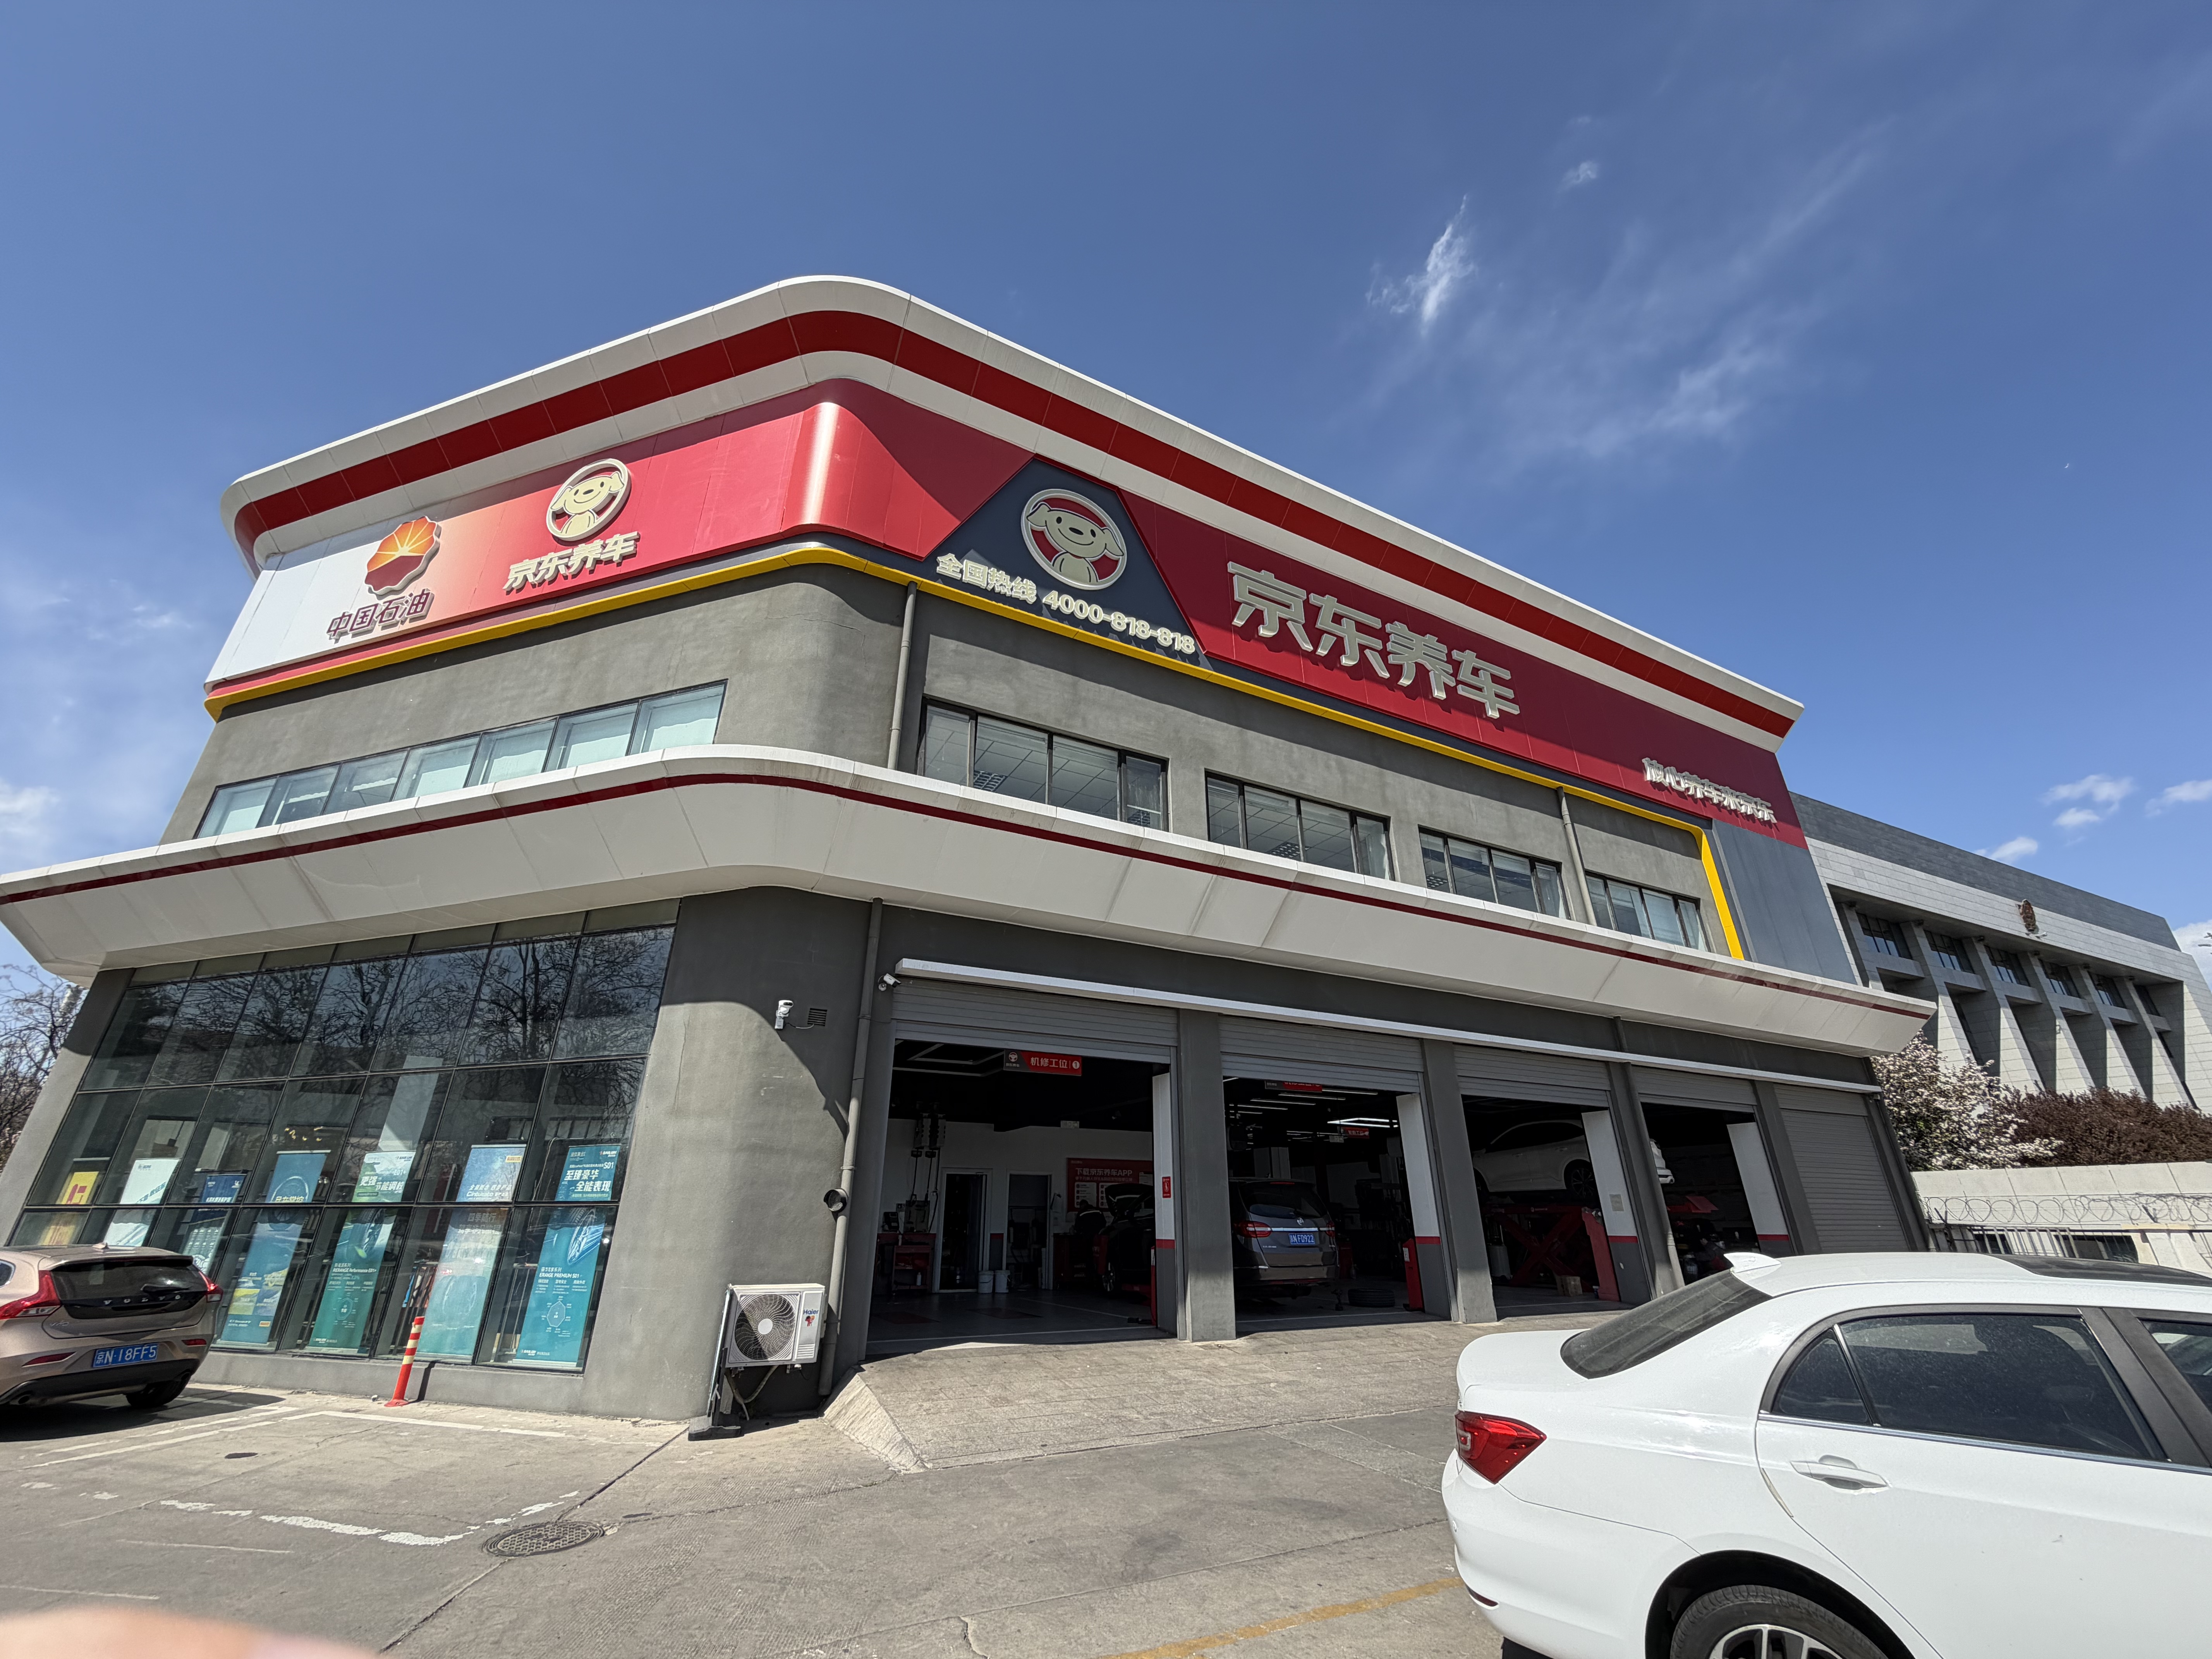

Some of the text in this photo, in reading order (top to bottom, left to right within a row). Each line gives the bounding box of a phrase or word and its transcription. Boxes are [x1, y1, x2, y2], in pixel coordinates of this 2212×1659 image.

[503, 531, 640, 592] 京东养车
[326, 588, 434, 639] 中国石油
[936, 553, 1195, 654] 全国热线 4000-818-818
[1227, 561, 1520, 719] 京东养车
[1642, 757, 1778, 823] 放心养车来京东
[1030, 1057, 1068, 1069] 机修工位
[359, 1176, 378, 1186] 更强
[574, 1180, 611, 1192] 全能表现
